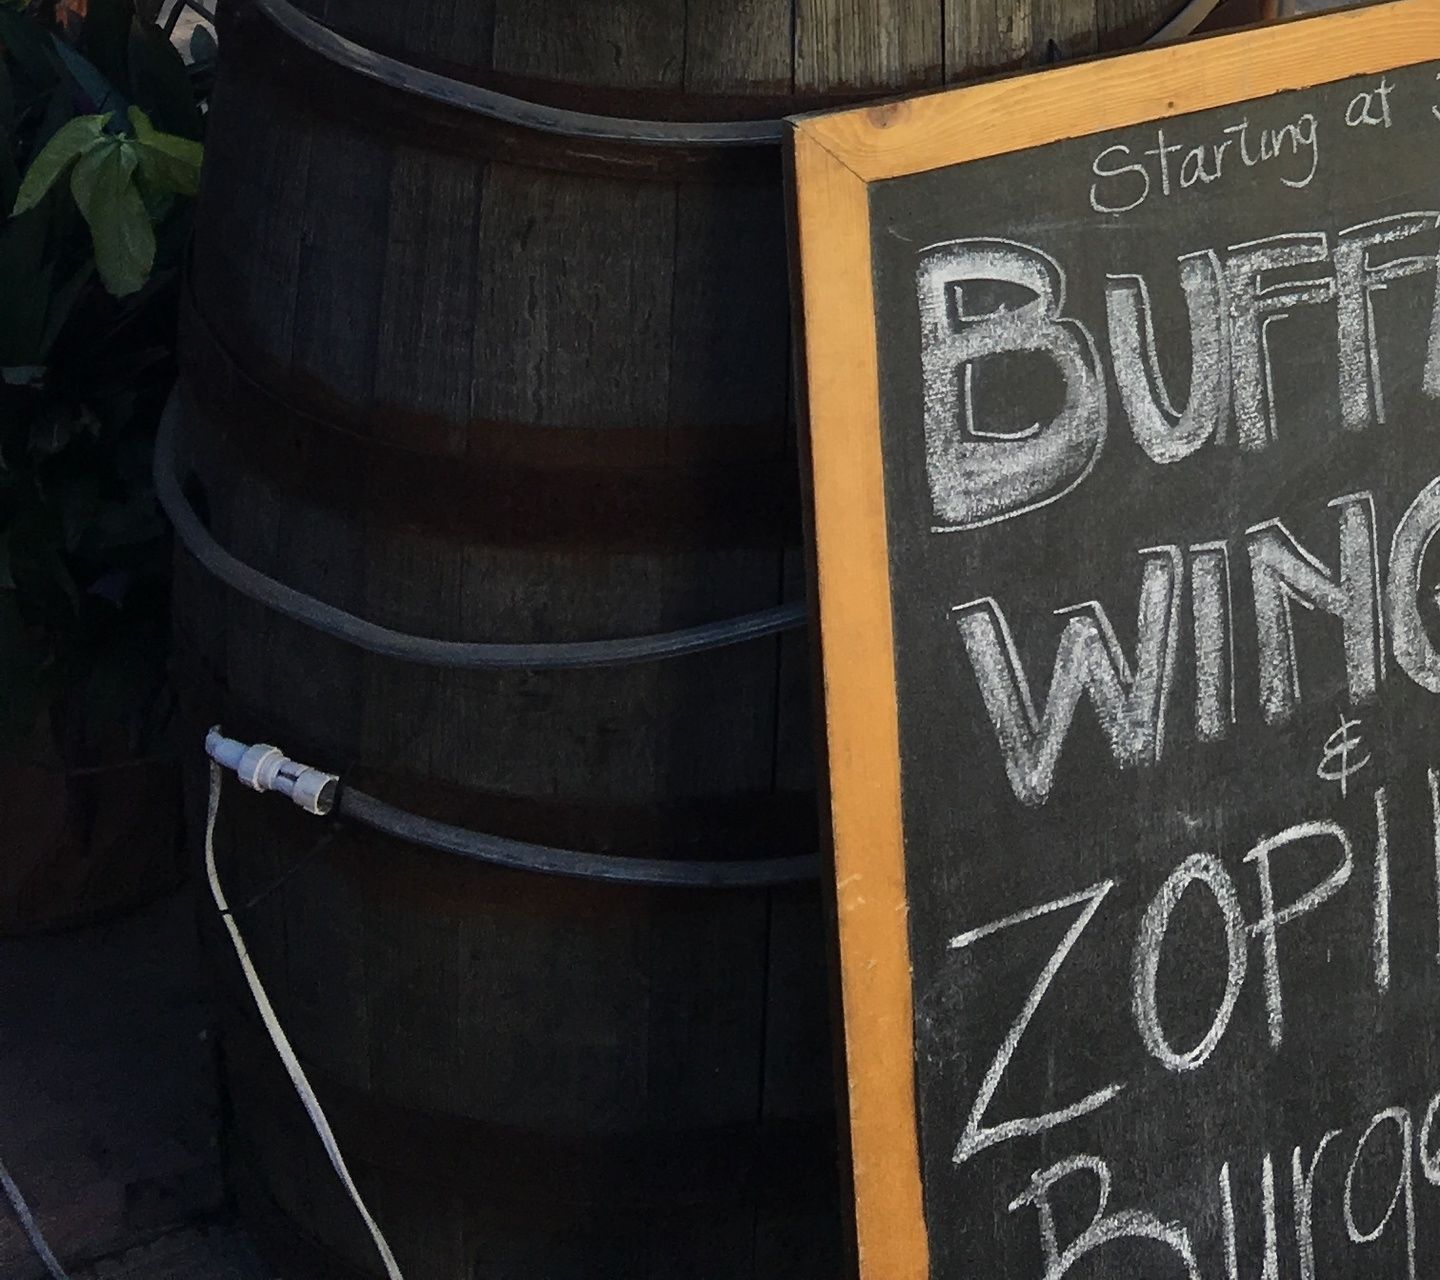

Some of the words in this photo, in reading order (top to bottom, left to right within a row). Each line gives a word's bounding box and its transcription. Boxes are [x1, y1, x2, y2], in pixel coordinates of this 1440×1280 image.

[1089, 114, 1319, 215] Starting
[1344, 75, 1396, 129] at
[1316, 712, 1371, 797] &
